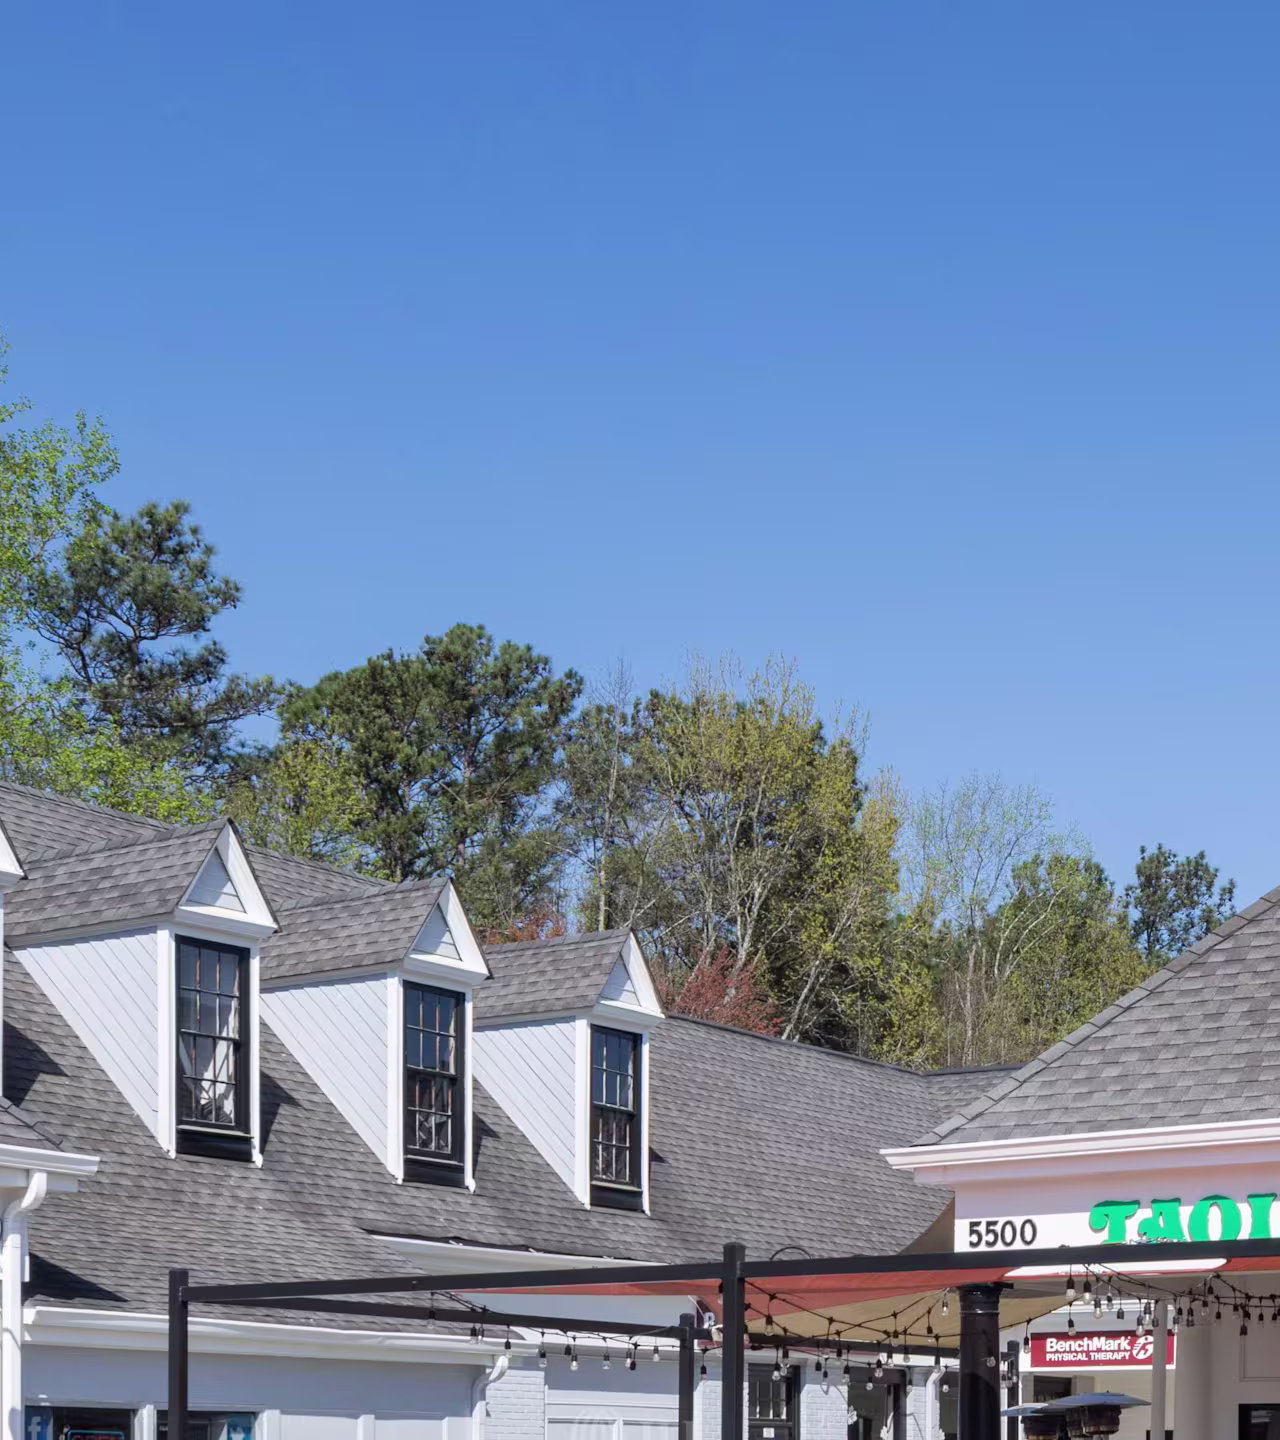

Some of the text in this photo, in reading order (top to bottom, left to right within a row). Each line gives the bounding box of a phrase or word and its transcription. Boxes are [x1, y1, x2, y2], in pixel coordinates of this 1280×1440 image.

[968, 1218, 1038, 1249] 5500
[1045, 1336, 1131, 1352] BenchMark
[1045, 1351, 1131, 1361] PHYSICAL THERAPY
